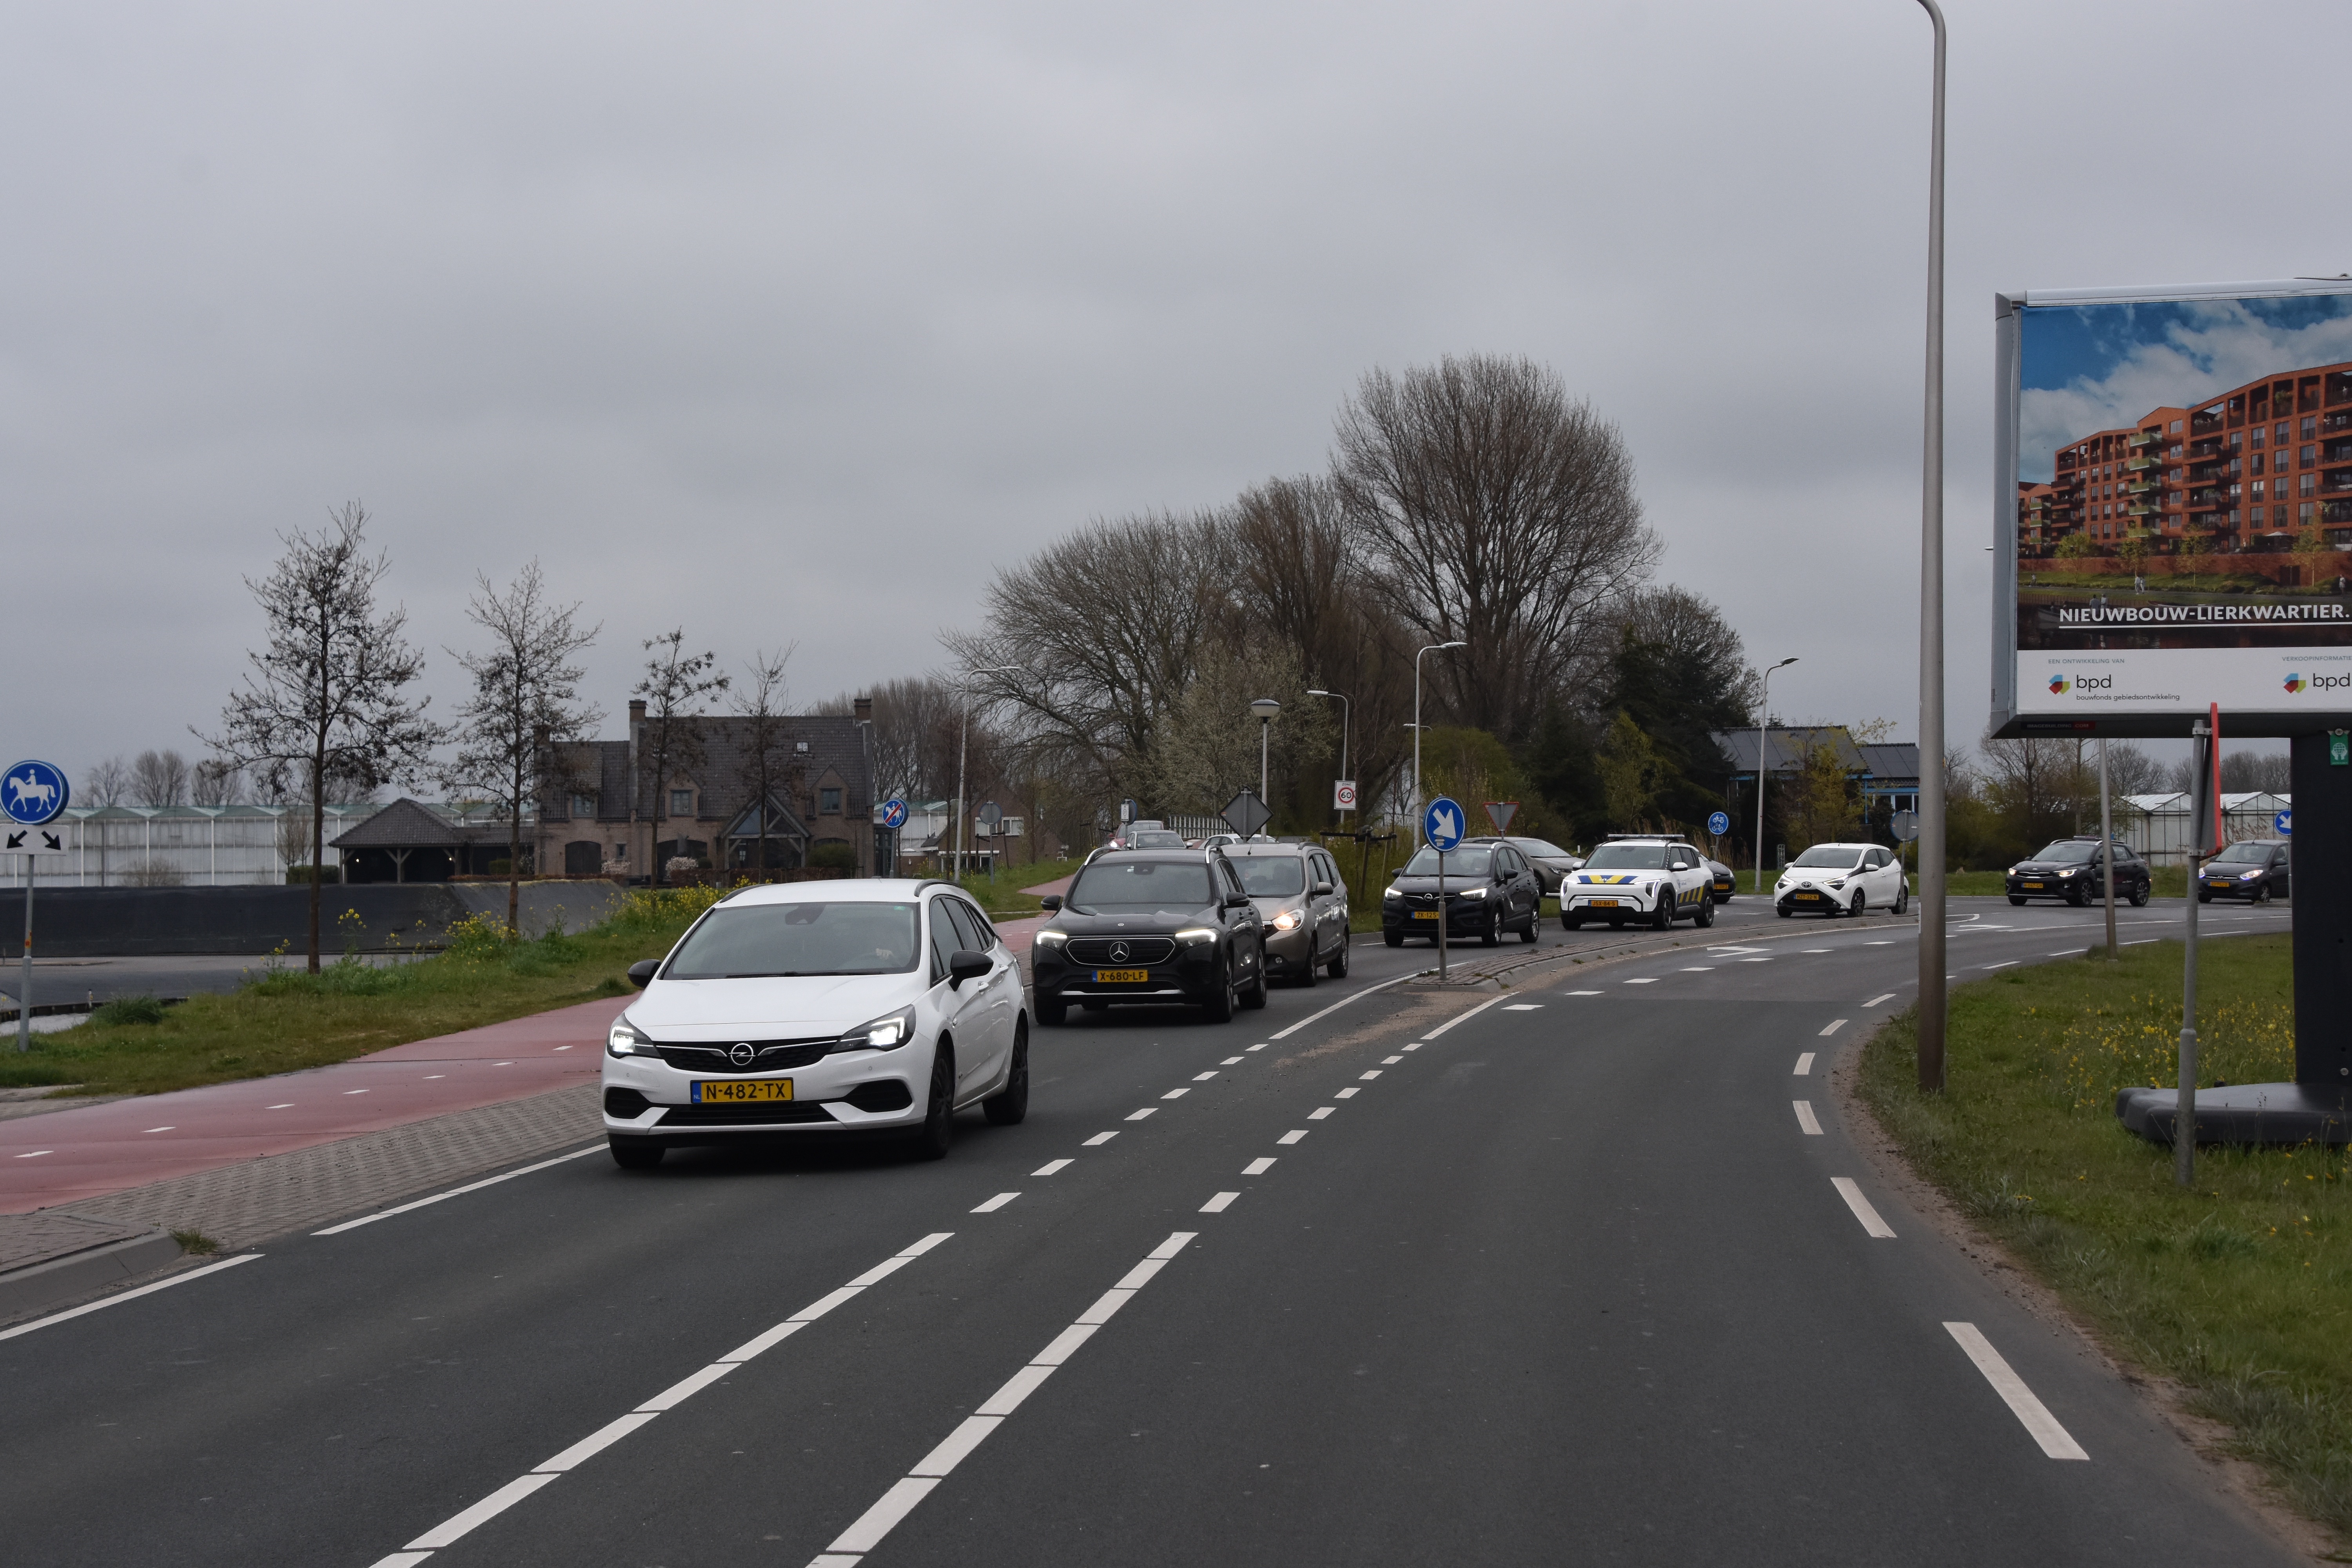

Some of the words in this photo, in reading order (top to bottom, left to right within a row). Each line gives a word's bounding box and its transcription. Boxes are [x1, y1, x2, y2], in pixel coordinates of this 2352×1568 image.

[2060, 604, 2350, 622] NIEUWBOUW-LIERKWARTIER.
[2076, 674, 2111, 693] bpd
[2313, 672, 2350, 691] bpd
[1100, 971, 1144, 980] X-680-LF
[706, 1083, 786, 1100] N-482-TX
